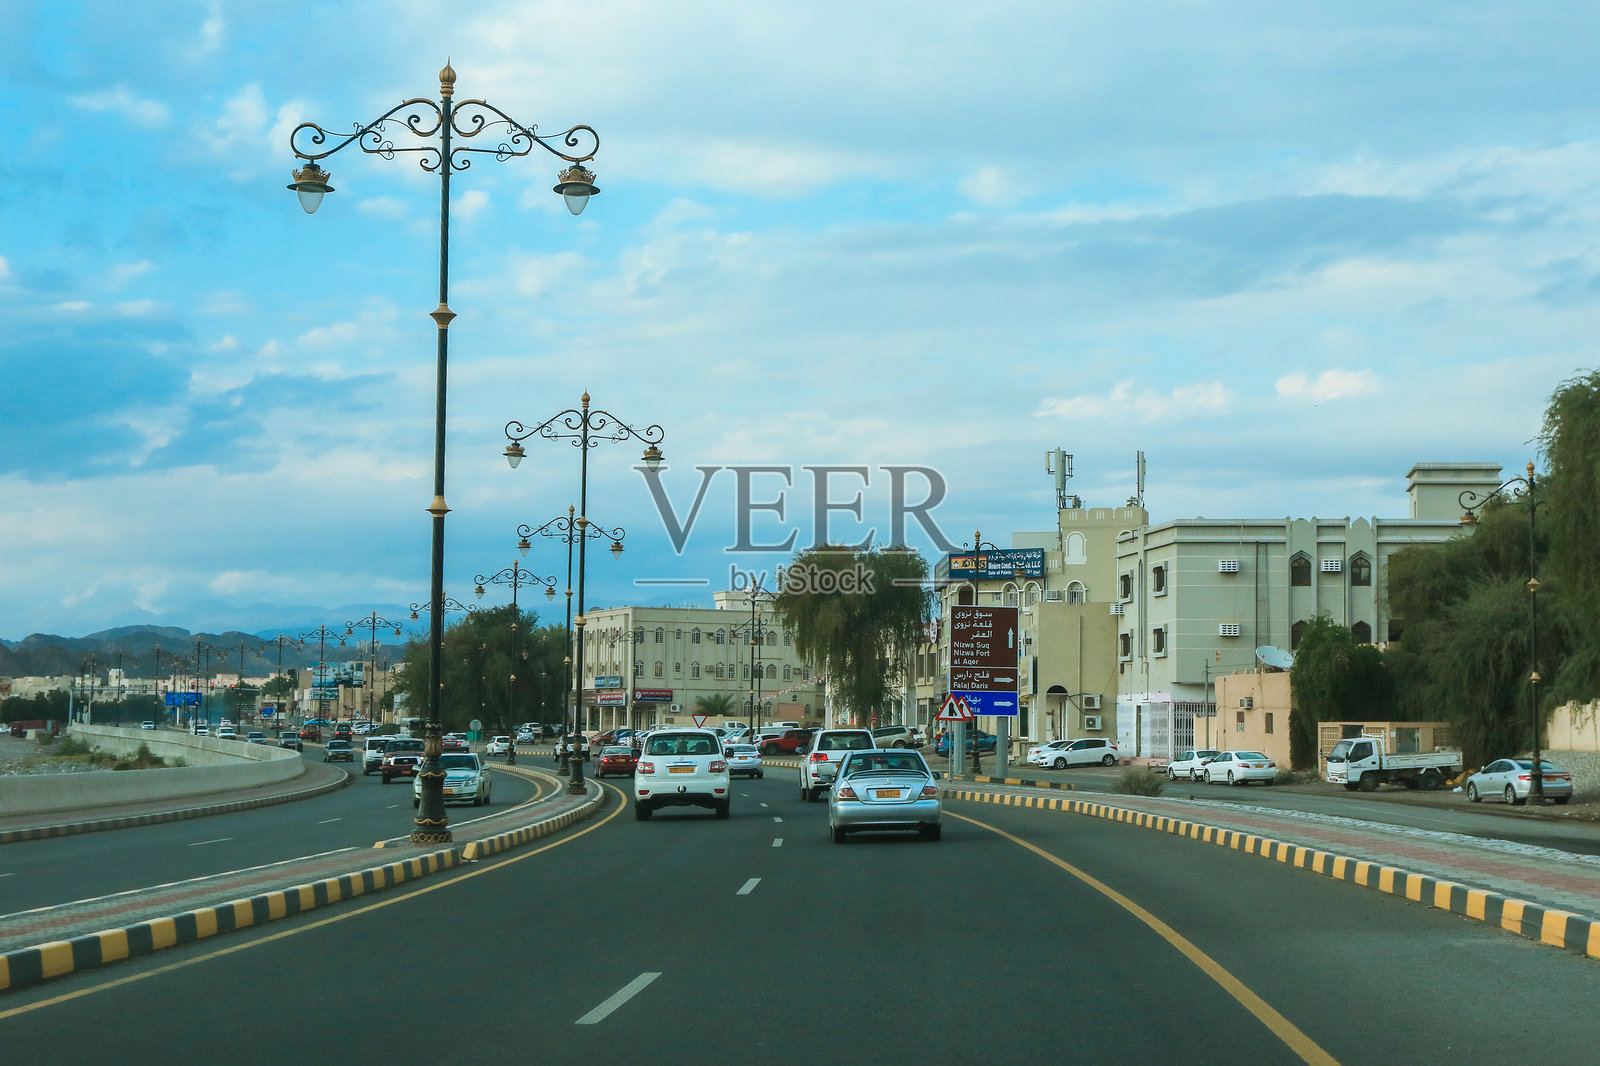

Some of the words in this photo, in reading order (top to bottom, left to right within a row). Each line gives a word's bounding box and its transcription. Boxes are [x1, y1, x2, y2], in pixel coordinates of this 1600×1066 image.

[974, 610, 993, 619] سوق
[977, 642, 990, 650] Suq
[954, 670, 972, 680] دارس
[974, 670, 990, 682] فلج
[954, 682, 970, 690] Falaj
